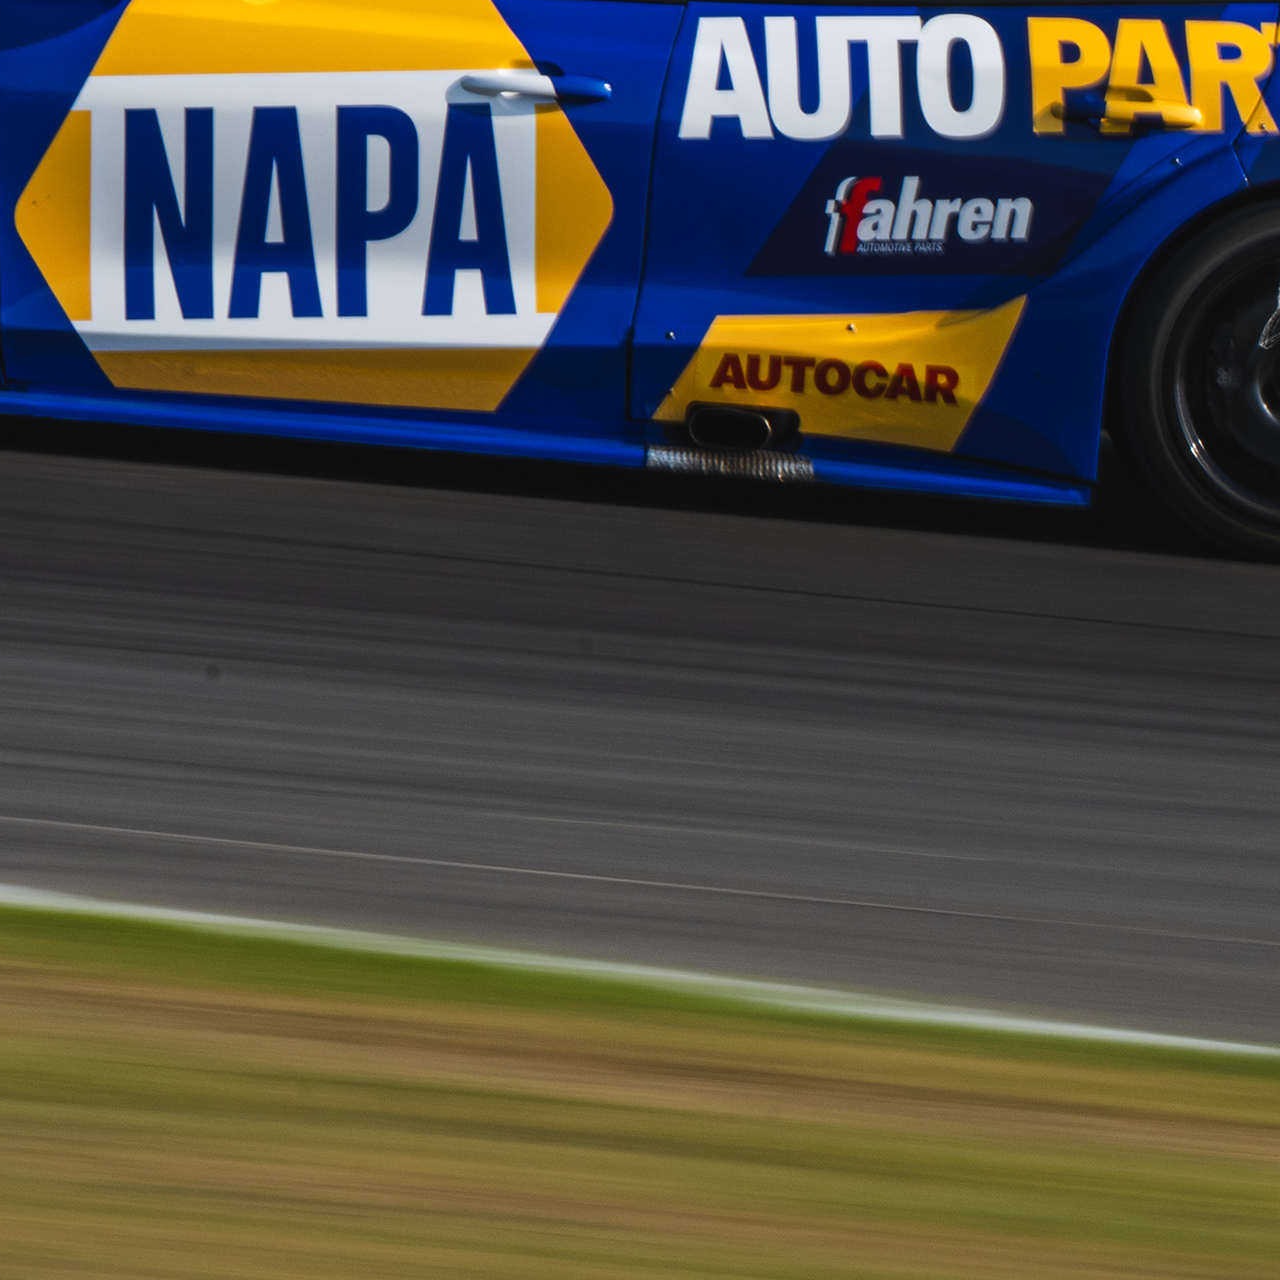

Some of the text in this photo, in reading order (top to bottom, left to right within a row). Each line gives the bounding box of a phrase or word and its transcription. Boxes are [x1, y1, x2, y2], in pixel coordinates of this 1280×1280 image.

[676, 12, 1006, 141] AUTO
[124, 101, 519, 321] NAPA
[824, 175, 1034, 256] fahren
[856, 241, 946, 254] AUTOMOTIVE PARTS
[708, 352, 961, 408] AUTOCAR
